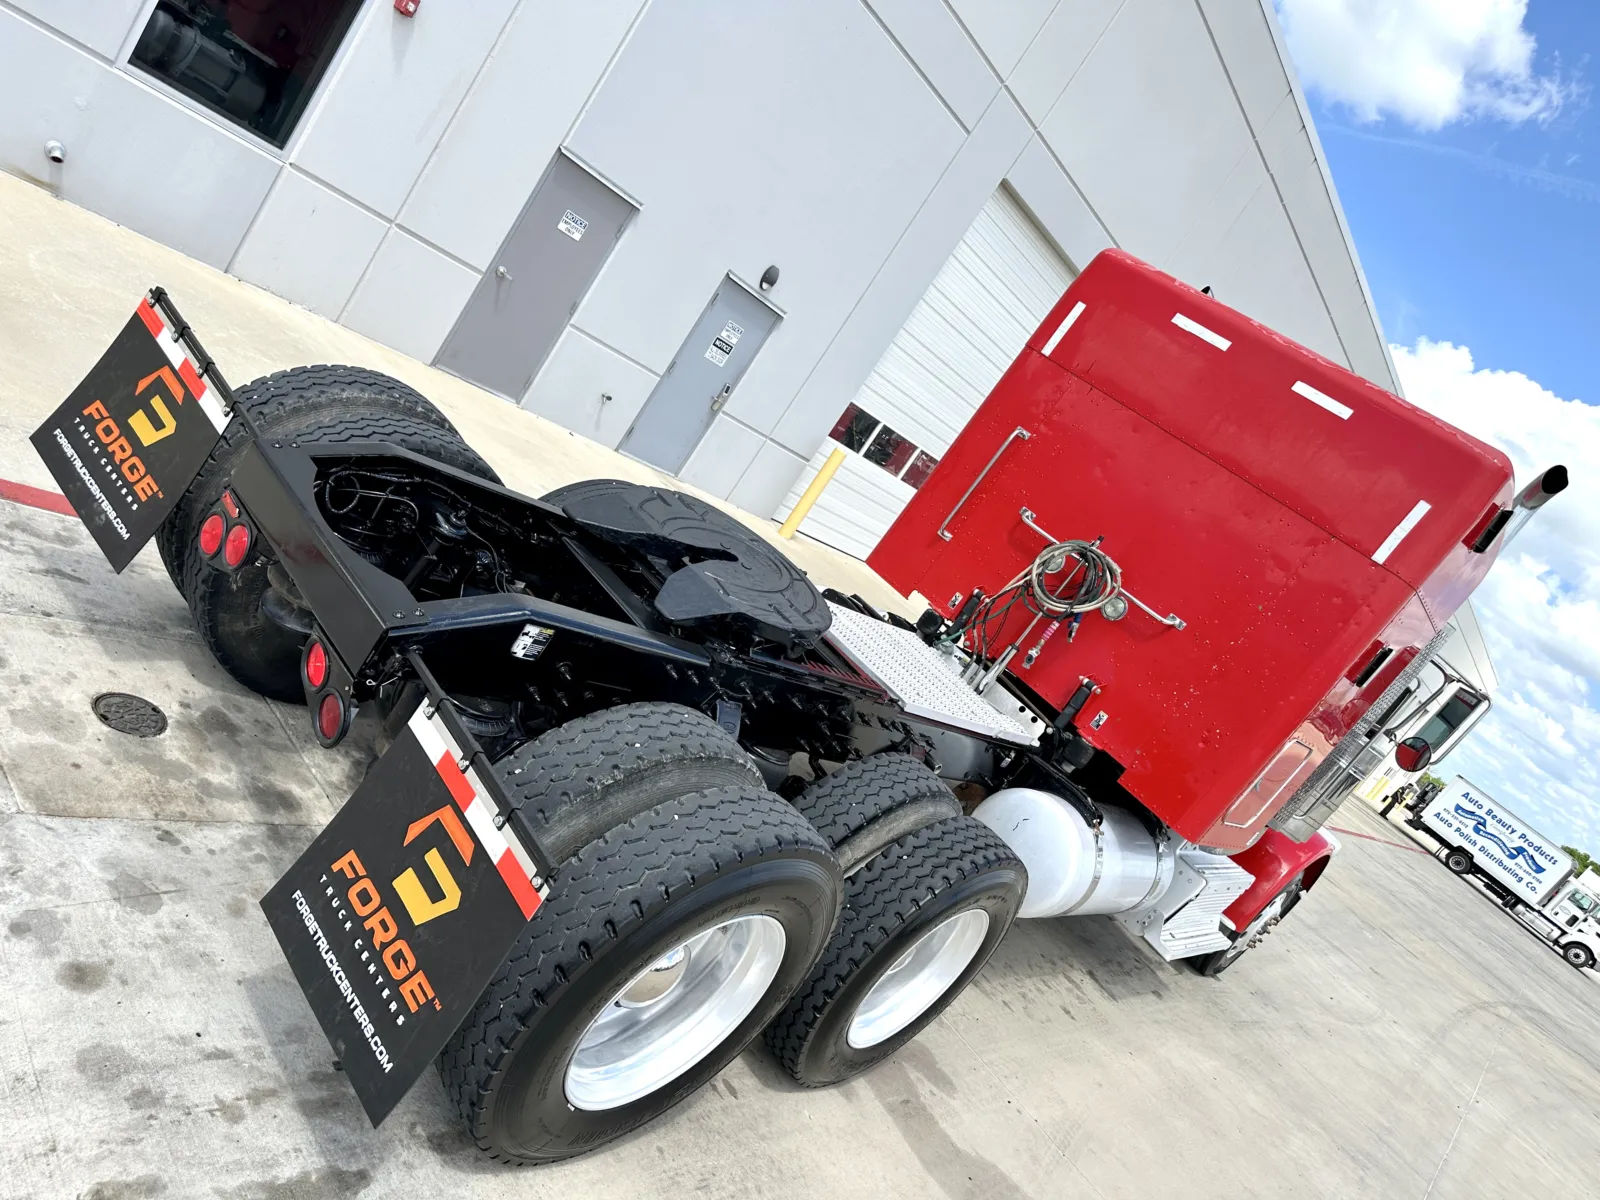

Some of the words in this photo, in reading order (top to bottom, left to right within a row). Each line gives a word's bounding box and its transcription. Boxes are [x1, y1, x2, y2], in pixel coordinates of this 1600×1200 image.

[566, 212, 586, 229] NOTICE
[715, 339, 731, 353] NOTICE
[53, 429, 130, 540] FORGETRUCKCENTERS.COM
[74, 418, 100, 454] TRUCK
[100, 459, 138, 511] CENTERS
[1433, 812, 1452, 829] Auto
[1454, 826, 1477, 847] Polish
[1478, 845, 1524, 883] Distributing
[1525, 882, 1538, 894] Co.
[1461, 792, 1484, 810] Auto
[1485, 808, 1517, 835] Beauty
[1518, 833, 1558, 866] Products
[291, 890, 394, 1073] FORGETRUCKCENTERS.COM
[319, 874, 353, 932] TRUCK
[354, 939, 405, 1026] CENTERS
